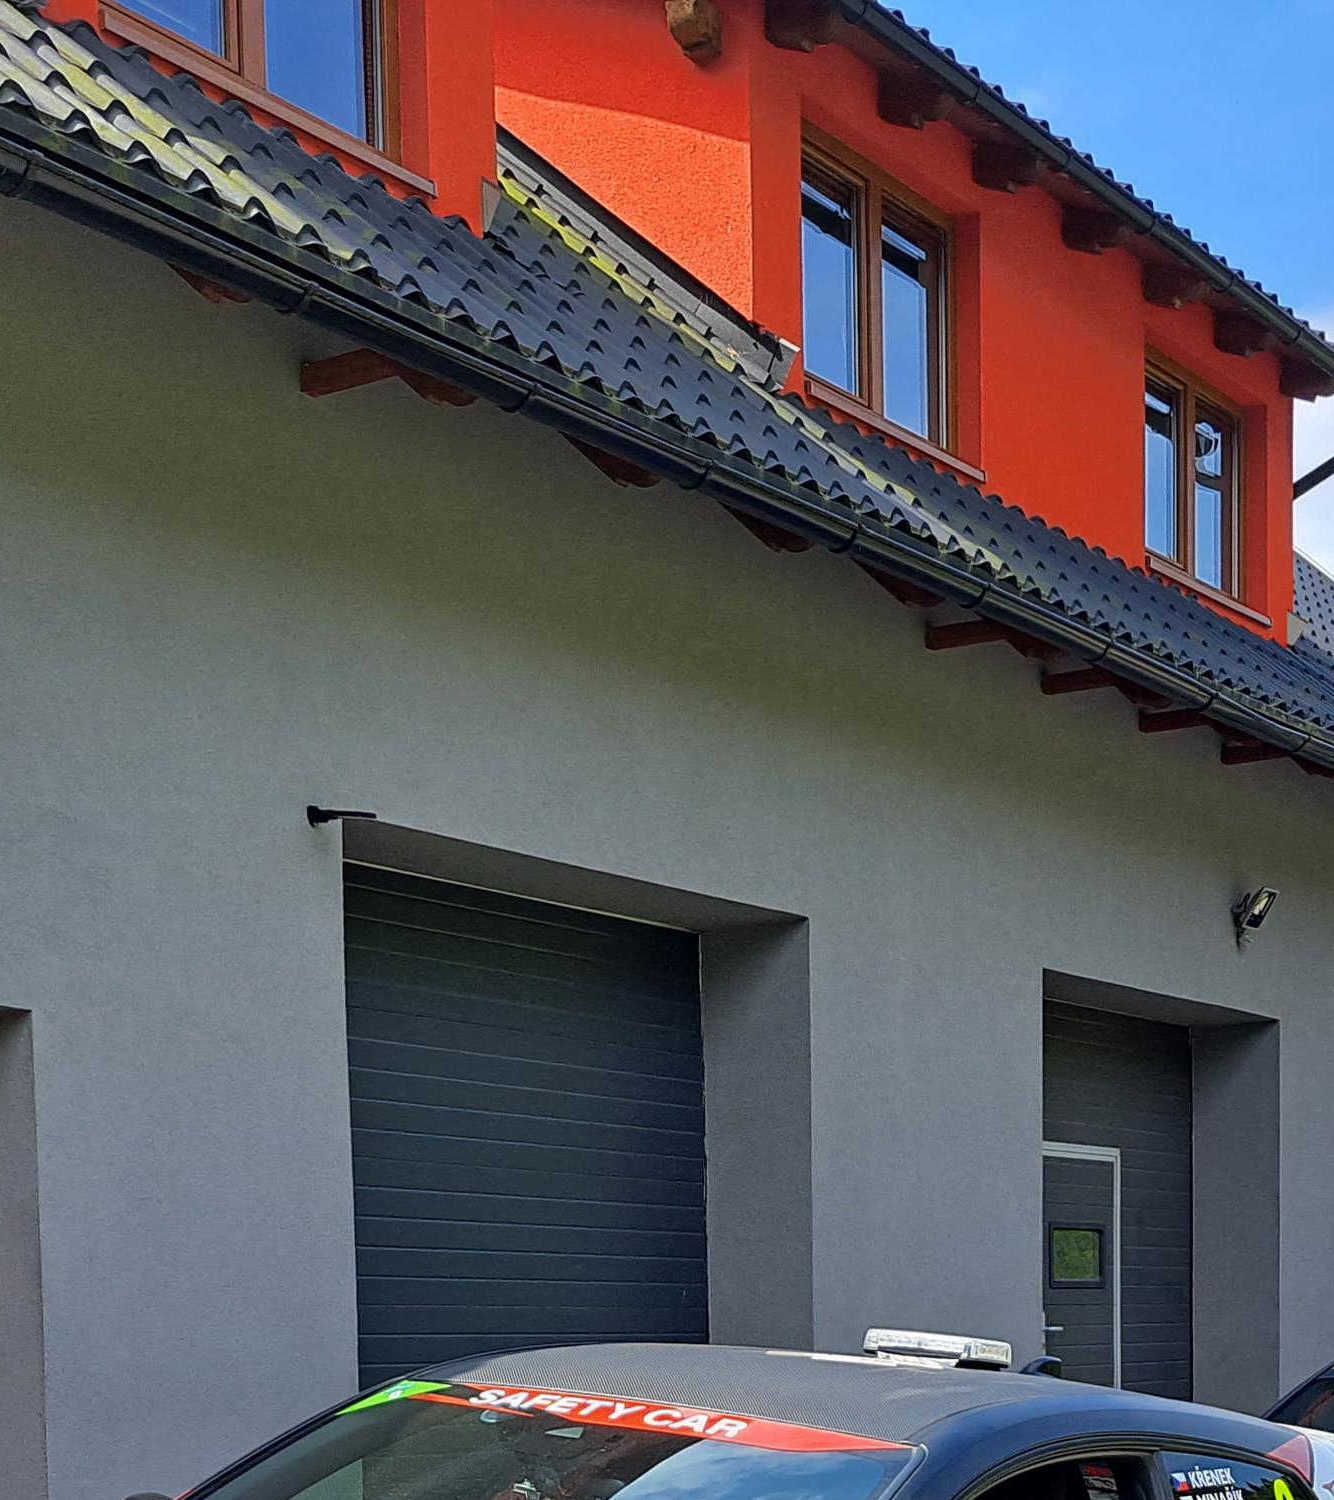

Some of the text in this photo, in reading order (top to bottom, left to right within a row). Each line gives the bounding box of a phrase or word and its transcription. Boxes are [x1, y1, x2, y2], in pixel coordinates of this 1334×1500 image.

[468, 1388, 749, 1439] SAFETY CAR
[1187, 1465, 1236, 1490] KŘENEK
